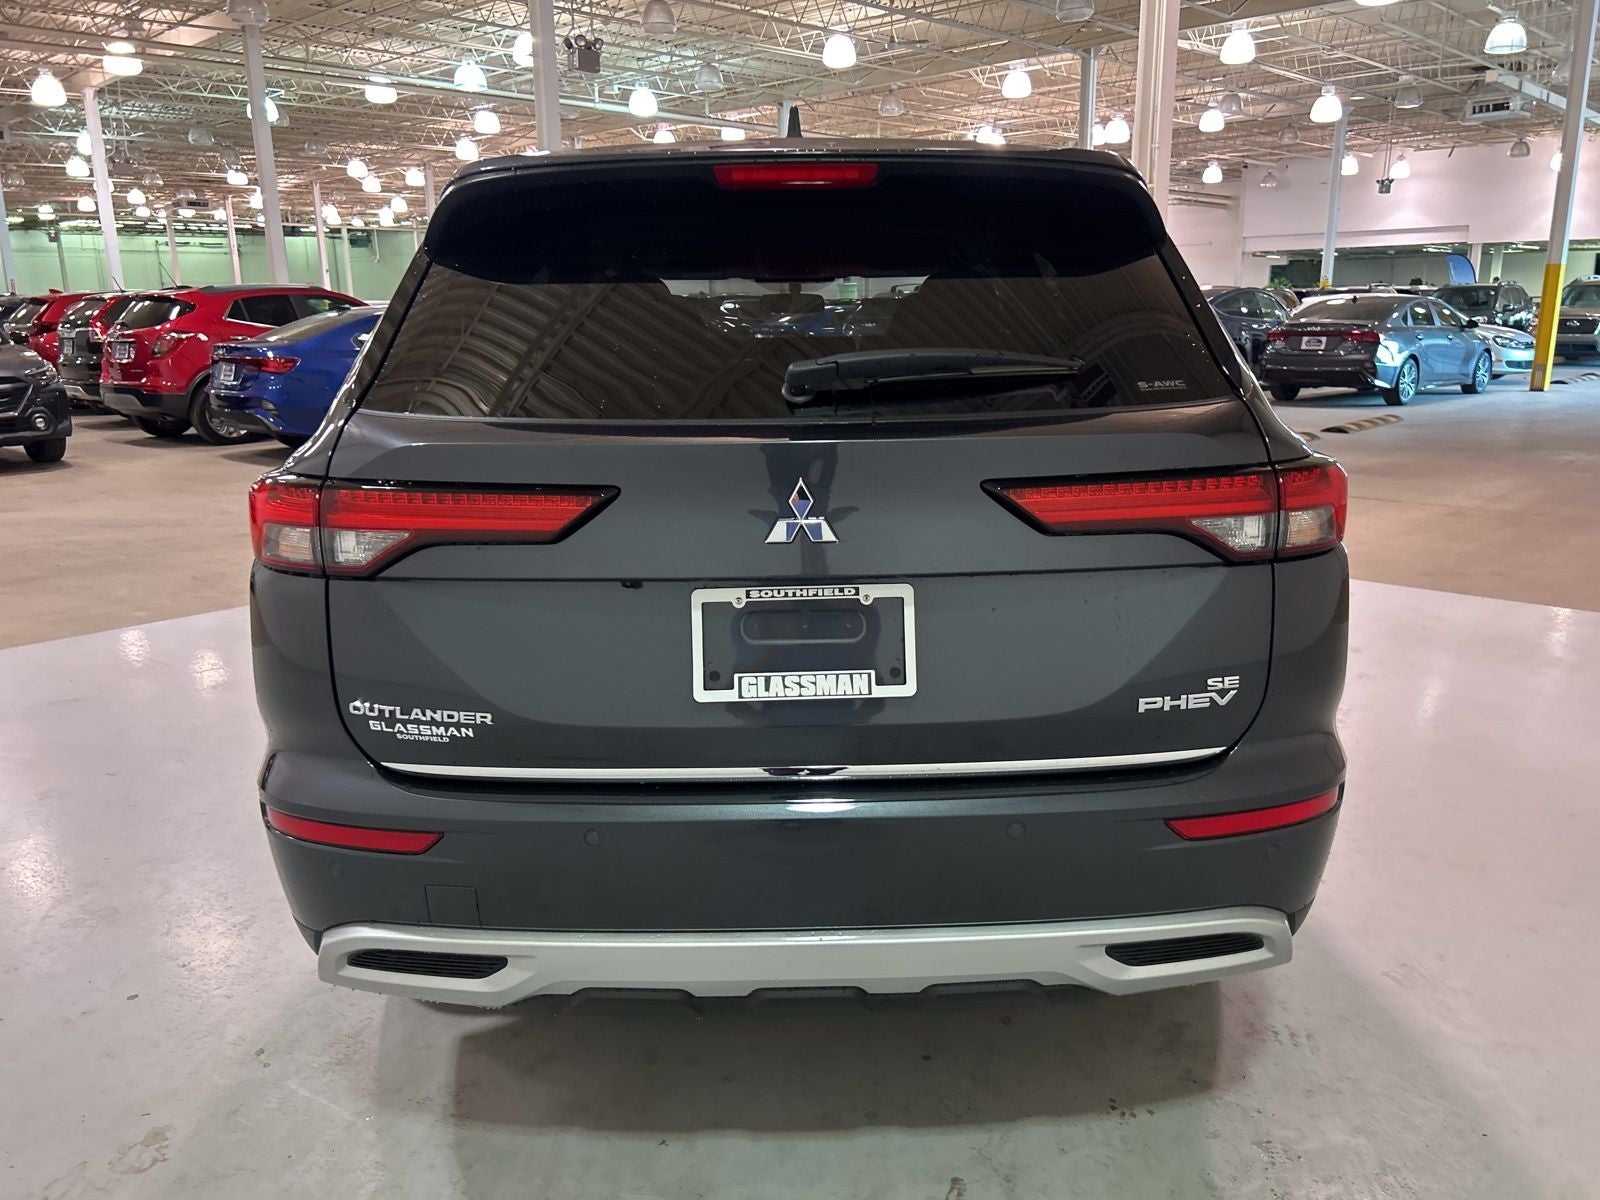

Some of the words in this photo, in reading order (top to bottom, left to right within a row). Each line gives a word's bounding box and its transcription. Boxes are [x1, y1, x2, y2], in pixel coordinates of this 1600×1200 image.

[1137, 379, 1186, 388] S-AWC
[749, 587, 856, 598] SOUTHFIELD
[740, 673, 869, 698] GLASSMAN
[1206, 675, 1240, 690] SE
[1138, 689, 1238, 713] PHEV
[348, 699, 495, 725] OUTLANDER
[368, 720, 475, 738] GLASSMAN
[396, 733, 450, 743] SOUTHFIELD
